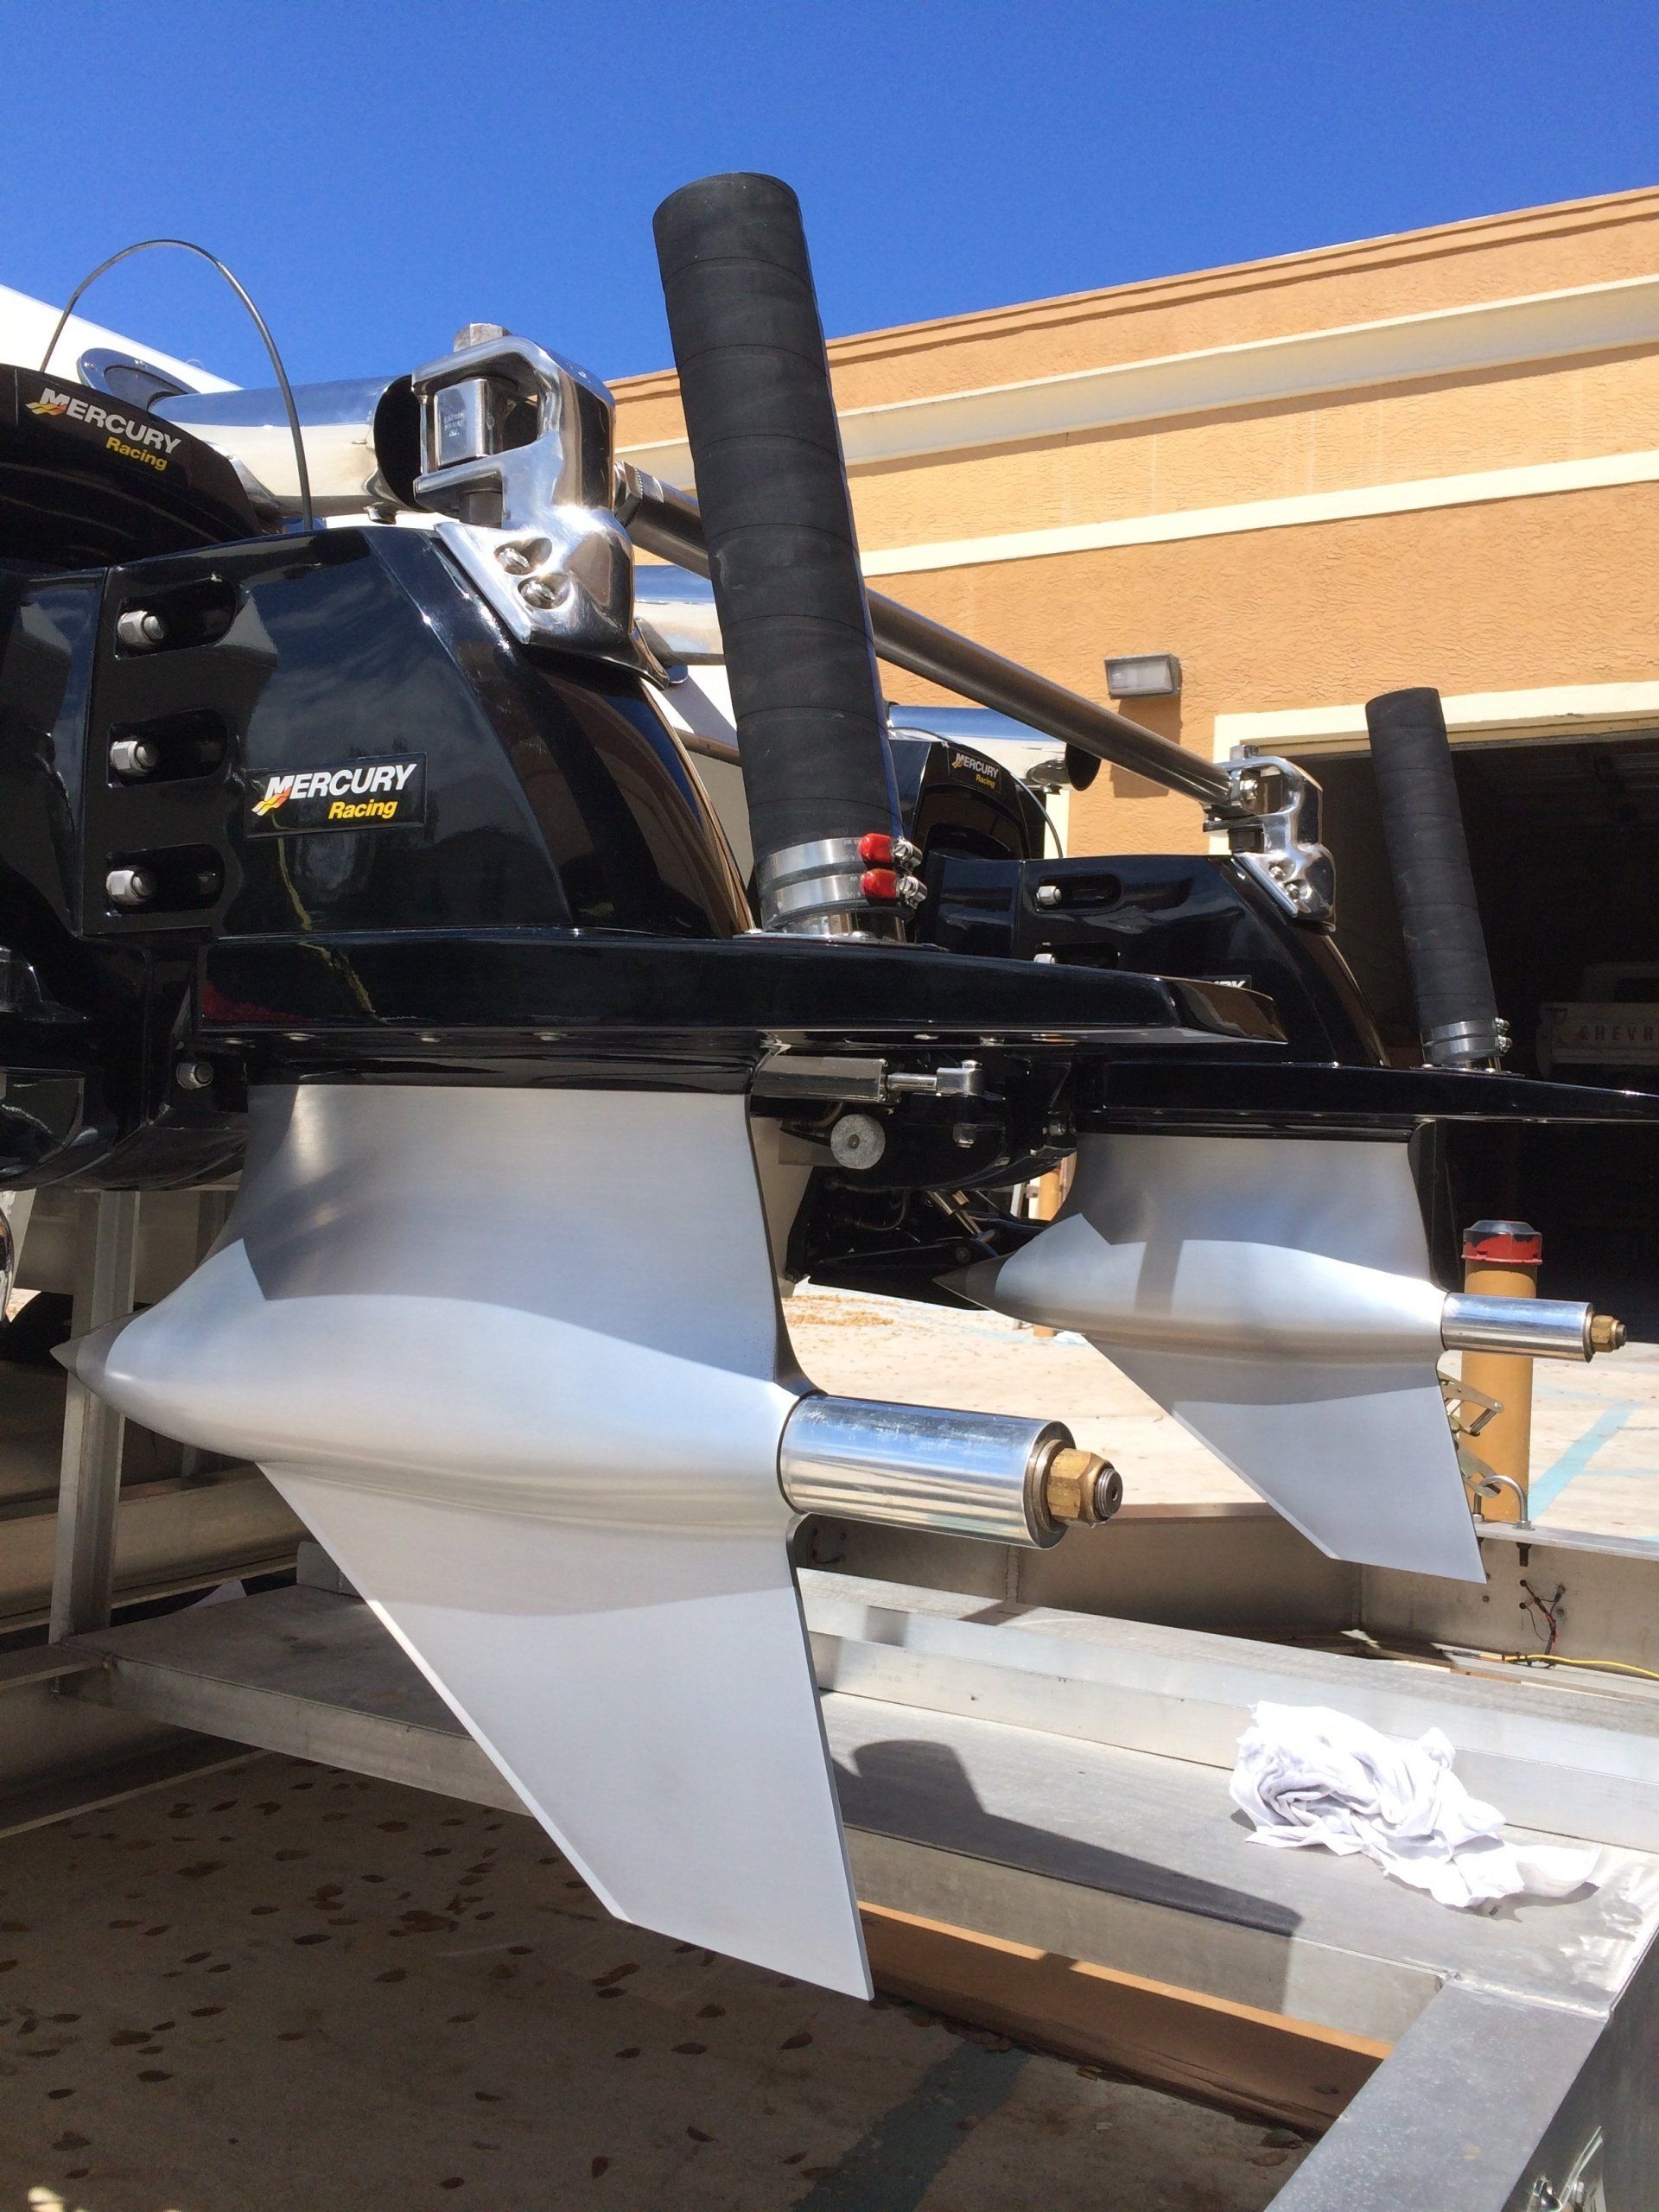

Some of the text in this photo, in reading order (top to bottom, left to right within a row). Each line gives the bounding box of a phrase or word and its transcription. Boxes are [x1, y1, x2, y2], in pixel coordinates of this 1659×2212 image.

[39, 387, 181, 454] MERCURY
[105, 436, 168, 471] Racing
[955, 753, 999, 779] MERCURY
[976, 773, 996, 789] Racing
[264, 763, 417, 802] MERCURY
[327, 798, 398, 819] Racing
